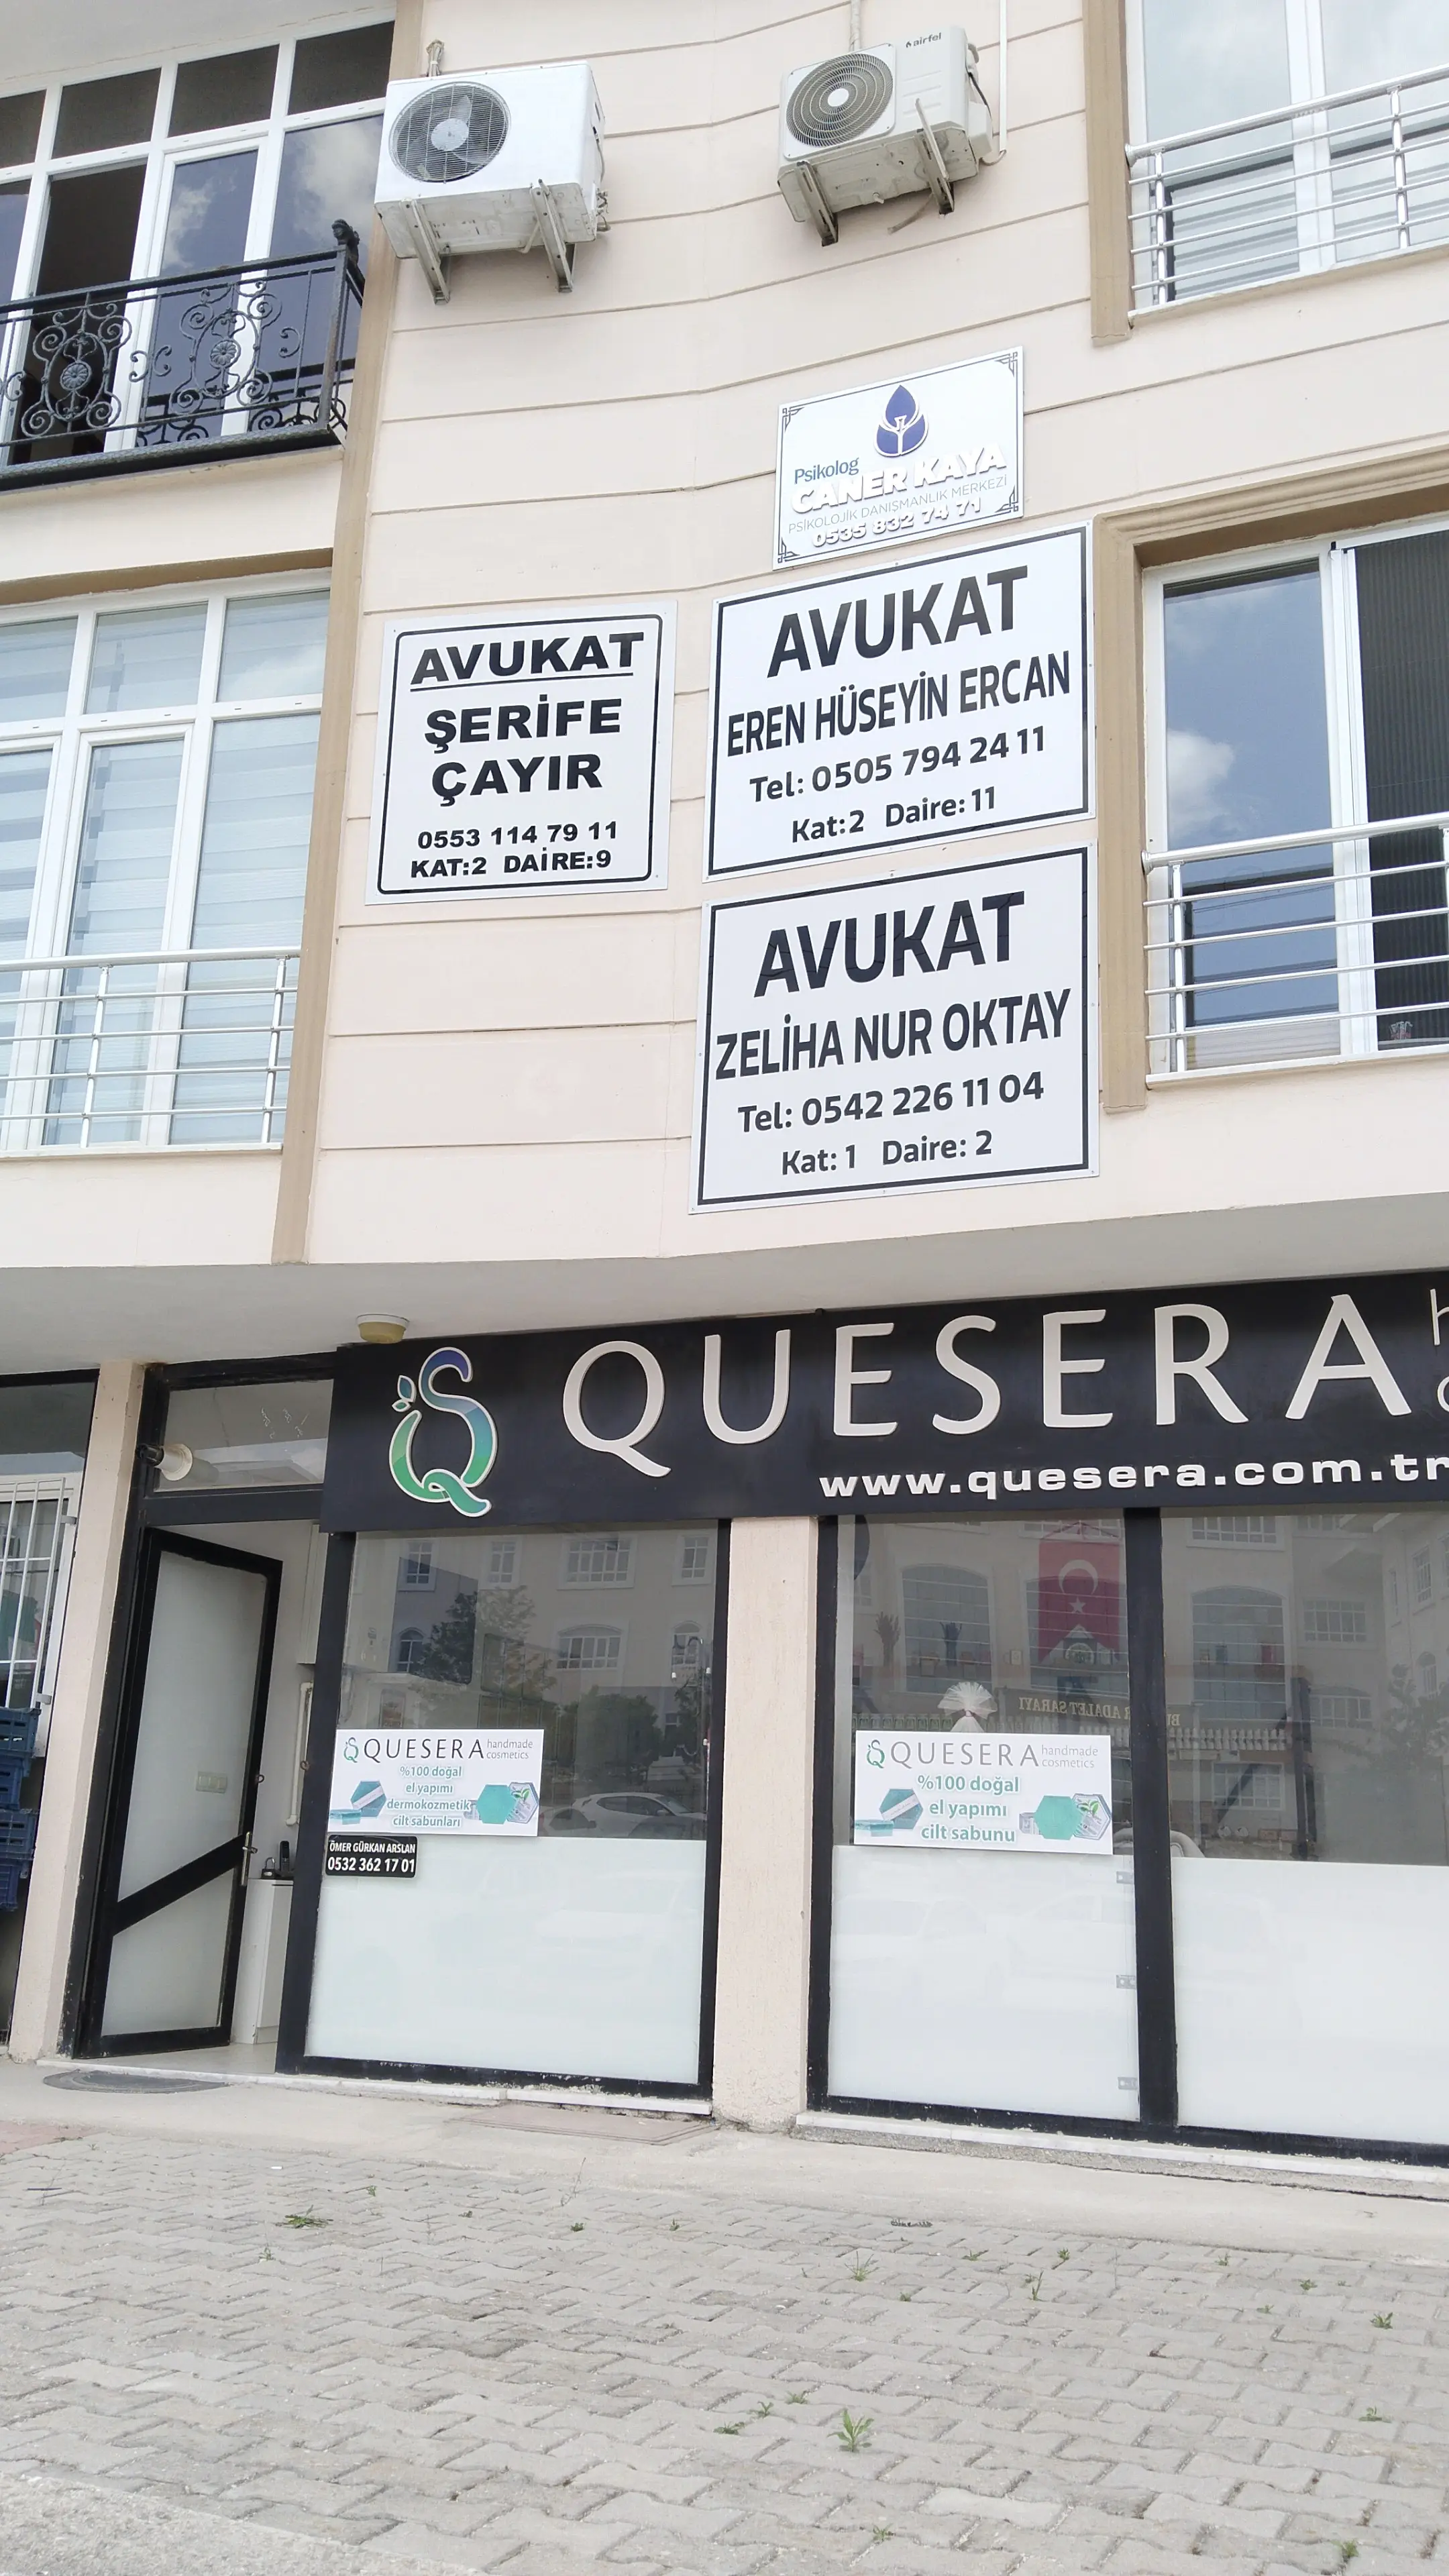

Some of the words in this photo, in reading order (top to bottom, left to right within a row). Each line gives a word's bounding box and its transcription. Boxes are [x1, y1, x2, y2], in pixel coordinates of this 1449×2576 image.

[914, 32, 941, 46] airfel
[791, 468, 908, 513] CANER
[914, 443, 1007, 488] KAYA
[794, 458, 859, 484] Psikolog
[788, 508, 857, 533] PSİKOLOJİK
[861, 490, 948, 518] DANIŞMANLIK
[951, 474, 1007, 497] MERKEZİ
[812, 523, 867, 547] 0535
[872, 513, 914, 535] 832
[922, 504, 949, 524] 74
[956, 497, 981, 516] 71
[767, 566, 1027, 678] AVUKAT
[411, 632, 643, 684] AVUKAT
[728, 702, 804, 757] EREN
[816, 672, 947, 740] HÜSEYİN
[961, 651, 1069, 712] ERCAN
[425, 694, 621, 753] ŞERİFE
[750, 771, 803, 802] Tel:
[812, 754, 892, 791] 0505
[903, 742, 961, 775] 794
[970, 733, 1009, 763] 24
[1018, 726, 1042, 754] 11
[433, 754, 602, 806] ÇAYIR
[793, 810, 863, 843] Kat:2
[886, 798, 965, 826] Daire:
[972, 786, 994, 811] 11
[419, 829, 480, 849] 0553
[491, 826, 537, 845] 114
[547, 824, 578, 842] 79
[589, 821, 616, 839] 11
[411, 857, 486, 877] KAT:2
[504, 847, 610, 873] DAİRE:9
[754, 891, 1024, 998] AVUKAT
[716, 1014, 843, 1079] ZELİHA
[855, 1009, 931, 1063] NUR
[943, 988, 1071, 1051] OKTAY
[738, 1102, 792, 1132] Tel:
[802, 1091, 882, 1125] 0542
[894, 1083, 953, 1115] 226
[963, 1078, 987, 1107] 11
[1000, 1071, 1043, 1102] 04
[783, 1150, 836, 1175] Kat:
[846, 1145, 855, 1168] 1
[883, 1136, 965, 1165] Daire:
[976, 1130, 991, 1155] 2
[563, 1293, 1411, 1477] QUESERA
[820, 1453, 1449, 1500] www.quesera.com.tr
[364, 1739, 484, 1763] QUESERA
[487, 1739, 533, 1749] handmade
[486, 1750, 529, 1760] cosmetics
[891, 1741, 1038, 1769] QUESERA
[1042, 1744, 1098, 1756] handmade
[1042, 1758, 1095, 1768] cosmetics
[400, 1766, 429, 1777] %100
[431, 1766, 462, 1779] doğal
[918, 1775, 965, 1790] %100
[969, 1776, 1019, 1795] doğal
[386, 1799, 470, 1810] dermokozmetik
[406, 1784, 416, 1793] el
[417, 1784, 453, 1795] yapımı
[393, 1815, 410, 1826] cilt
[411, 1816, 460, 1827] sabunları
[929, 1800, 947, 1815] el
[949, 1803, 1007, 1819] yapımı
[329, 1841, 352, 1851] ÖMER
[353, 1841, 385, 1853] GÜRKAN
[386, 1843, 415, 1854] ARSLAN
[920, 1825, 947, 1839] cilt
[951, 1825, 1016, 1842] sabunu
[328, 1857, 356, 1870] 0532
[359, 1858, 381, 1872] 362
[384, 1858, 398, 1872] 17
[401, 1859, 415, 1872] 01
